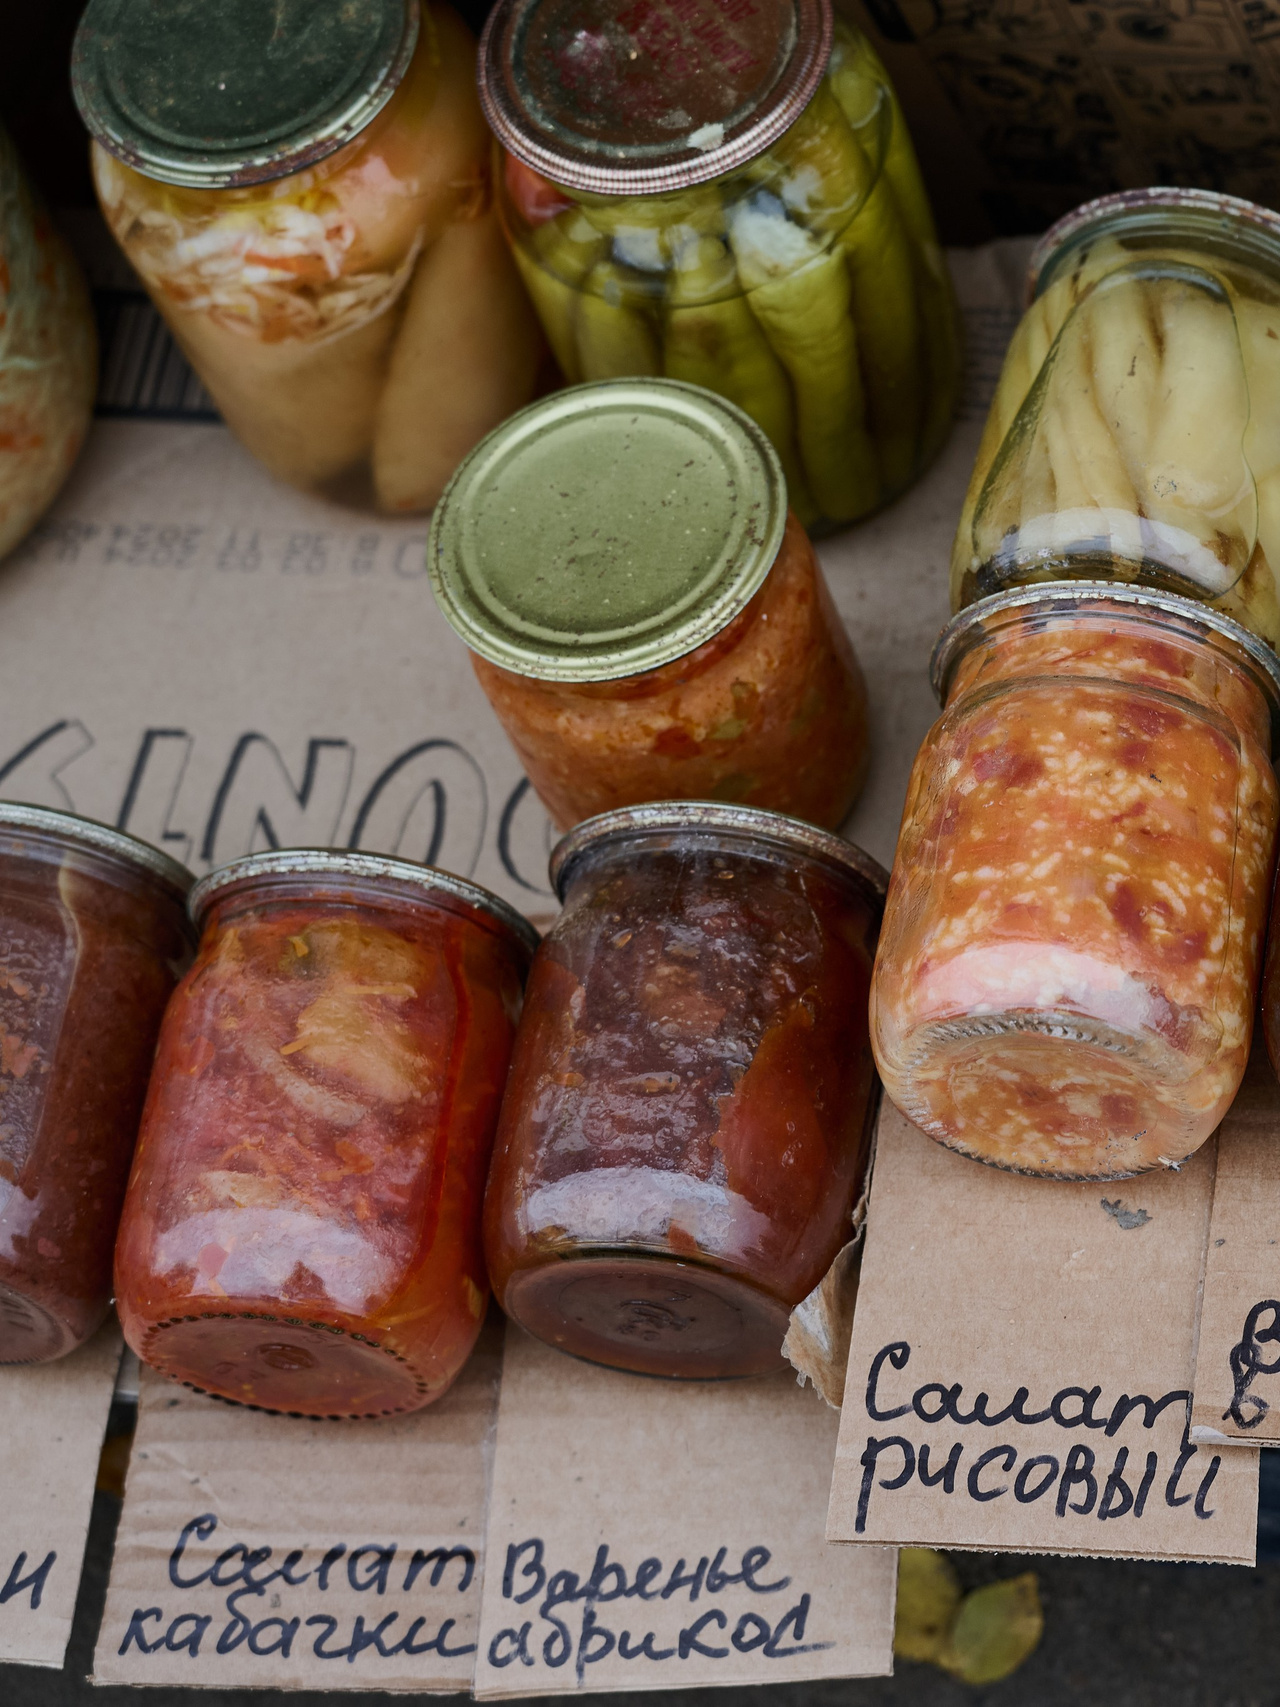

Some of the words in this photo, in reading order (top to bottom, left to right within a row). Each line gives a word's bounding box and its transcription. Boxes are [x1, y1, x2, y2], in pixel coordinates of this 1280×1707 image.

[865, 1341, 1193, 1446] Салат
[854, 1434, 1222, 1533] рисовый
[168, 1512, 476, 1595] Салат
[502, 1537, 792, 1604] Варенье
[117, 1585, 478, 1663] кабачки
